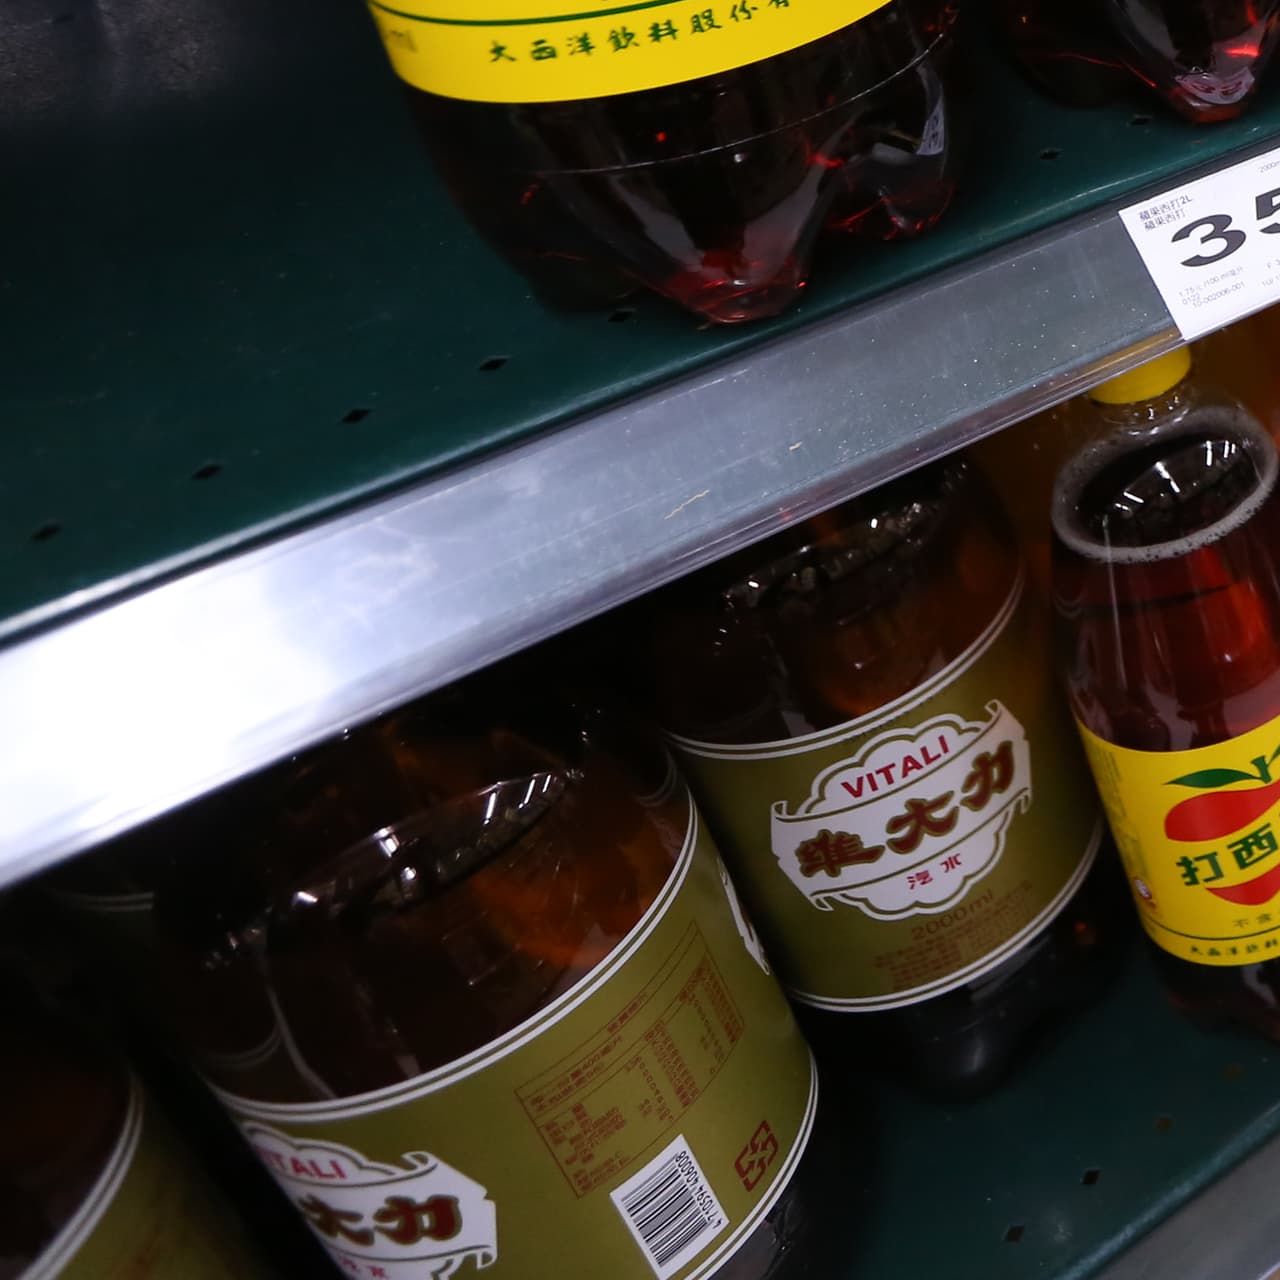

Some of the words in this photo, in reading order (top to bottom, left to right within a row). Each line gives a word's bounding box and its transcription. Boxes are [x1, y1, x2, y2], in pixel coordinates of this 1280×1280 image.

[841, 735, 950, 798] VITALI
[795, 740, 1015, 878] 維大力
[907, 853, 962, 890] 汽水
[675, 1150, 700, 1188] 406008
